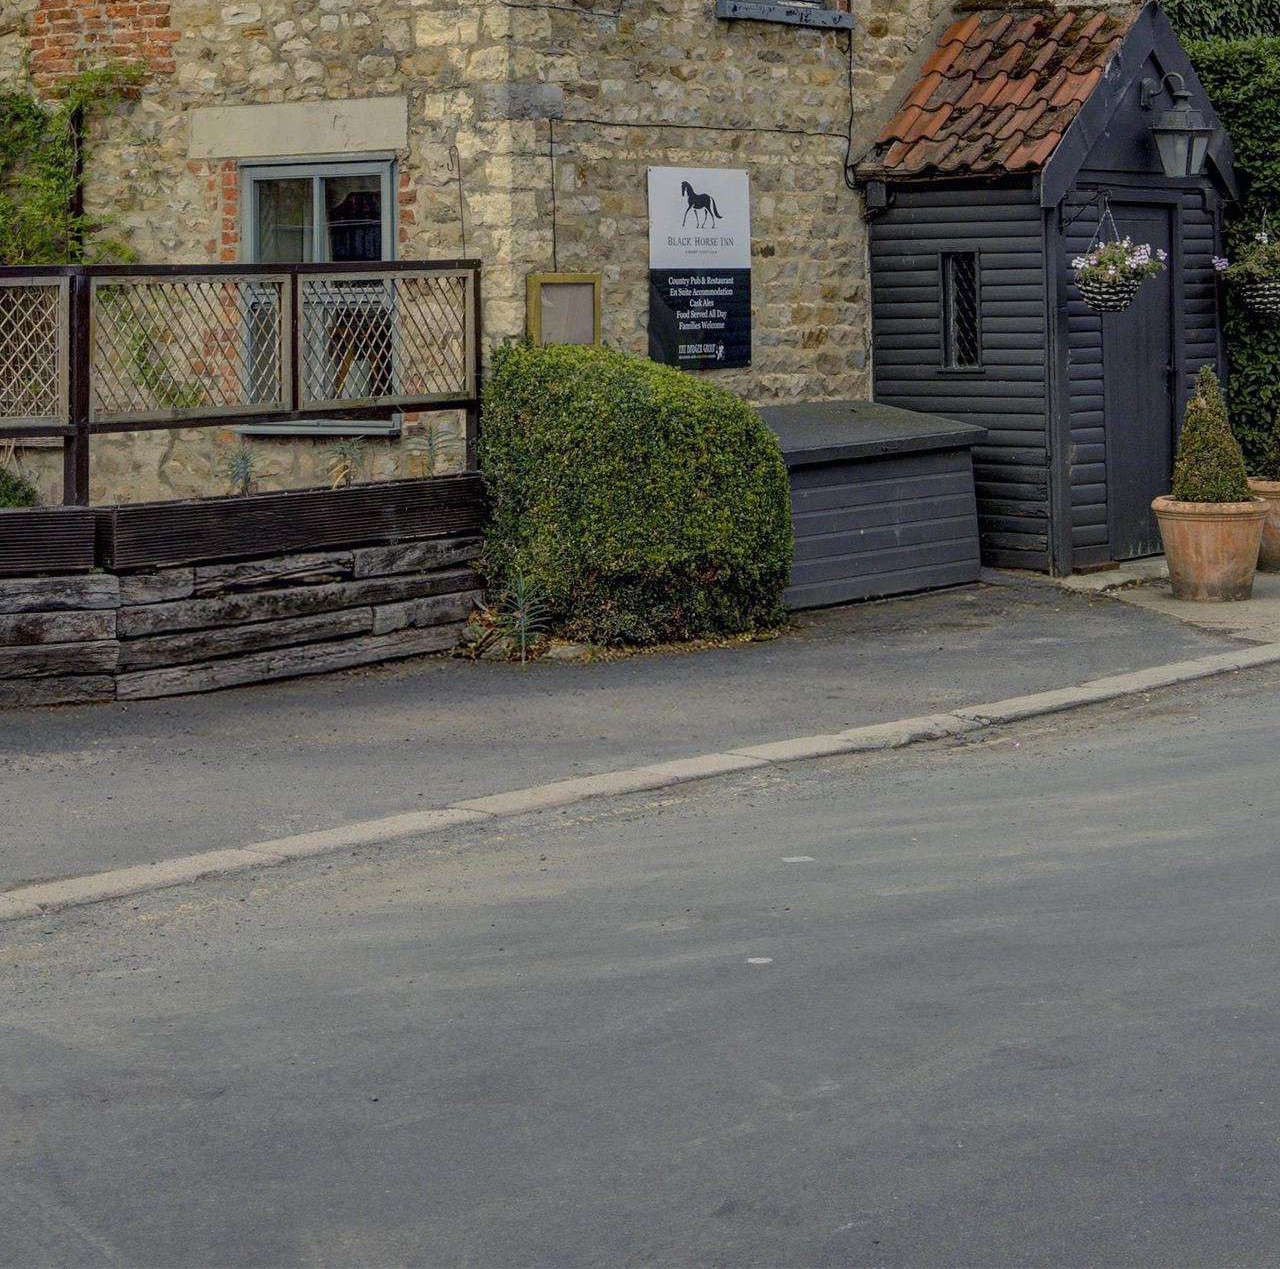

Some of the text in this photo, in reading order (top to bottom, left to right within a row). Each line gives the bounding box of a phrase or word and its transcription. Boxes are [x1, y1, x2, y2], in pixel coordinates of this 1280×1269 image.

[668, 237, 734, 246] BLACK HORSE INN
[668, 276, 690, 287] Country
[690, 276, 701, 284] Pub
[692, 287, 733, 296] Accommodation
[690, 299, 702, 307] Cask
[676, 310, 689, 319] Food
[691, 310, 708, 318] Served
[717, 310, 727, 319] Day
[679, 321, 725, 330] Families Welcome
